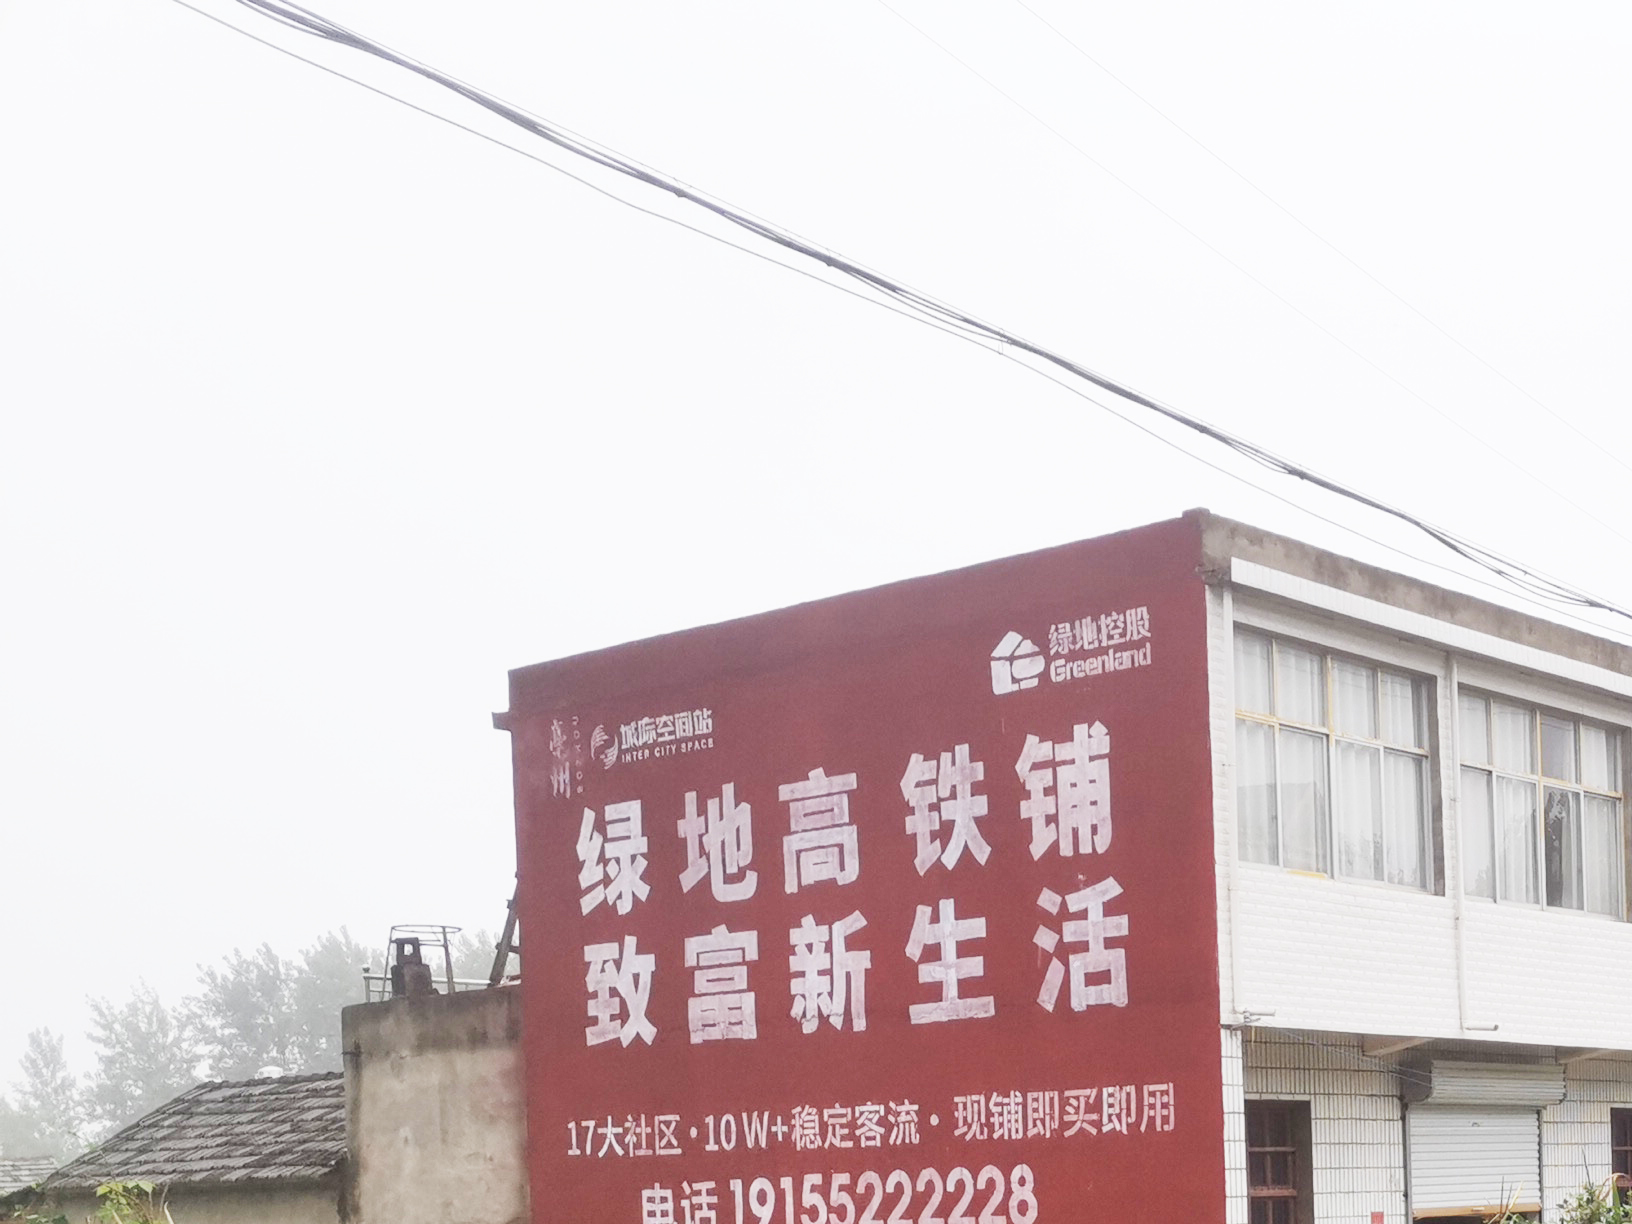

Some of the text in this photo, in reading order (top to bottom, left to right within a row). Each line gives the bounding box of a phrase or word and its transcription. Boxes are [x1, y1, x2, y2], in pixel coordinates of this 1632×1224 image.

[1048, 605, 1152, 657] 绿地控股
[1050, 641, 1152, 683] Greenland
[620, 707, 713, 750] 城际空间站
[654, 743, 677, 758] CITY
[680, 737, 714, 753] SPACE
[576, 720, 1112, 916] 绿地高铁铺
[583, 876, 1129, 1048] 致富新生活
